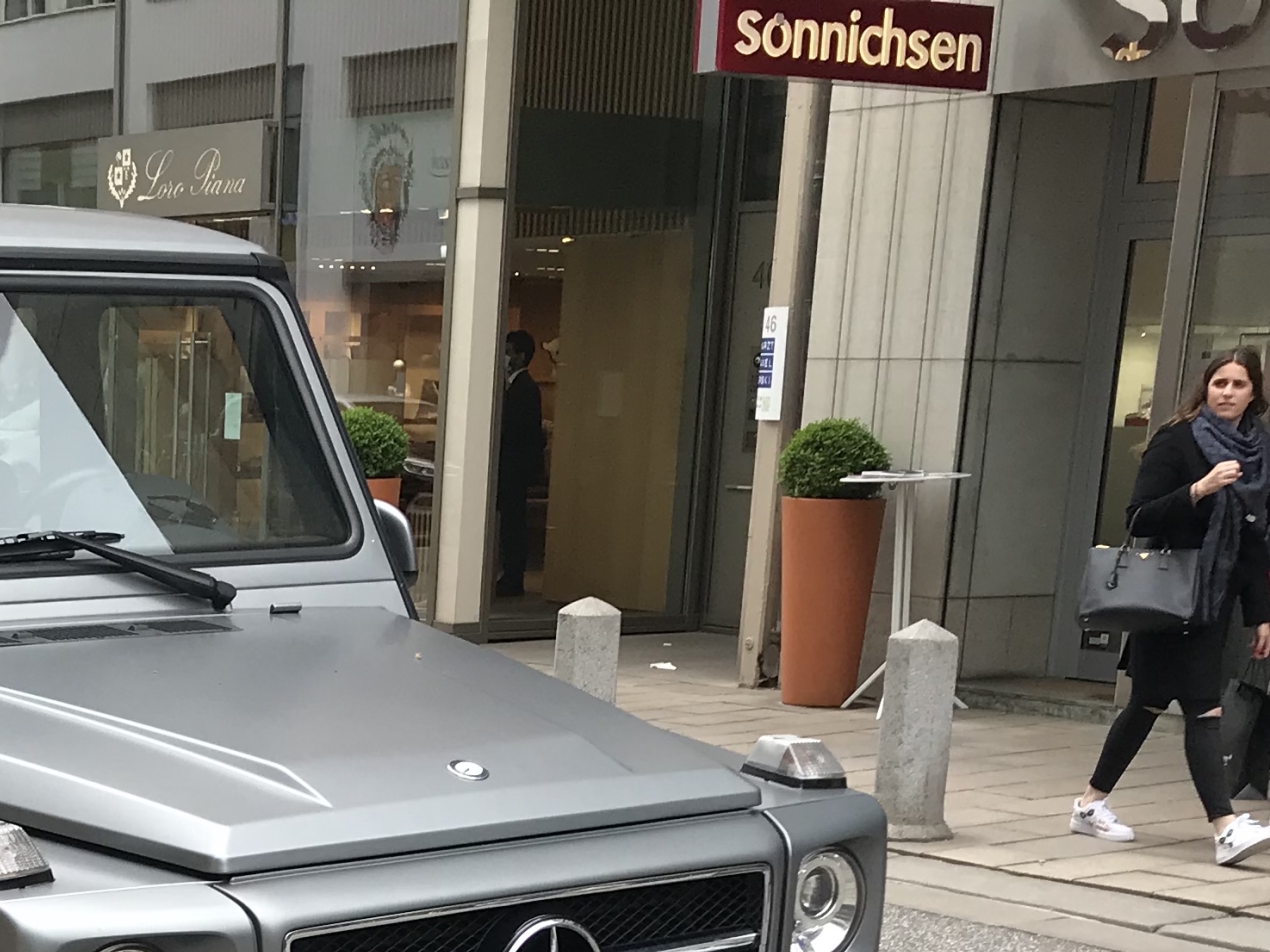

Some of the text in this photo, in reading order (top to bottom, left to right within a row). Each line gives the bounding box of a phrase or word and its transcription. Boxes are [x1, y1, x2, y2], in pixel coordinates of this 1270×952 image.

[137, 147, 246, 201] Loro Piana
[765, 314, 777, 333] 46
